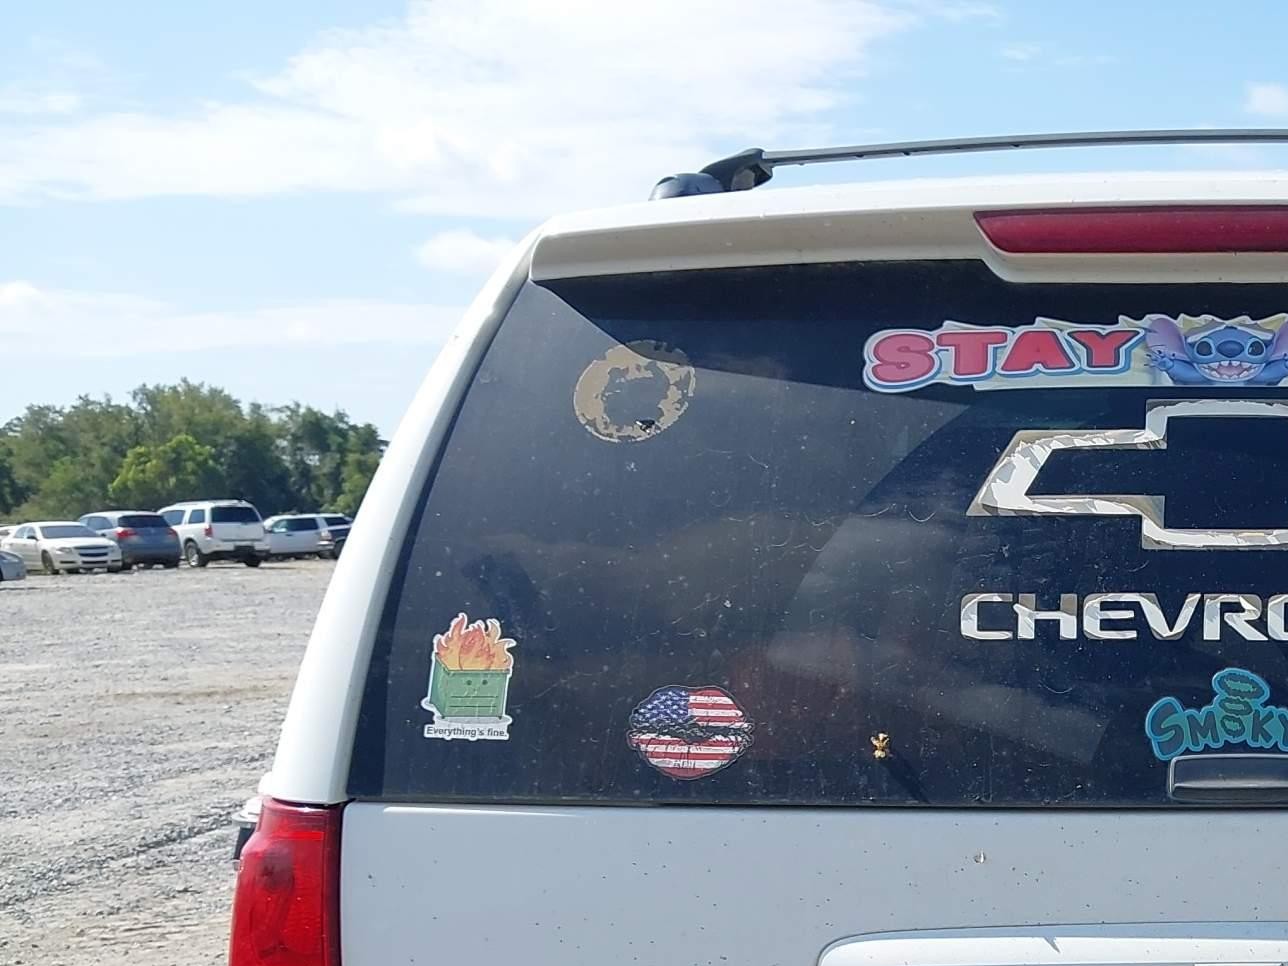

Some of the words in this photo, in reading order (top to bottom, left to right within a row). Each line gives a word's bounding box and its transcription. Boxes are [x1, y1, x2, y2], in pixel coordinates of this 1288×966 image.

[867, 325, 1142, 387] STAY
[426, 726, 485, 738] Everything's
[486, 727, 507, 738] fine.
